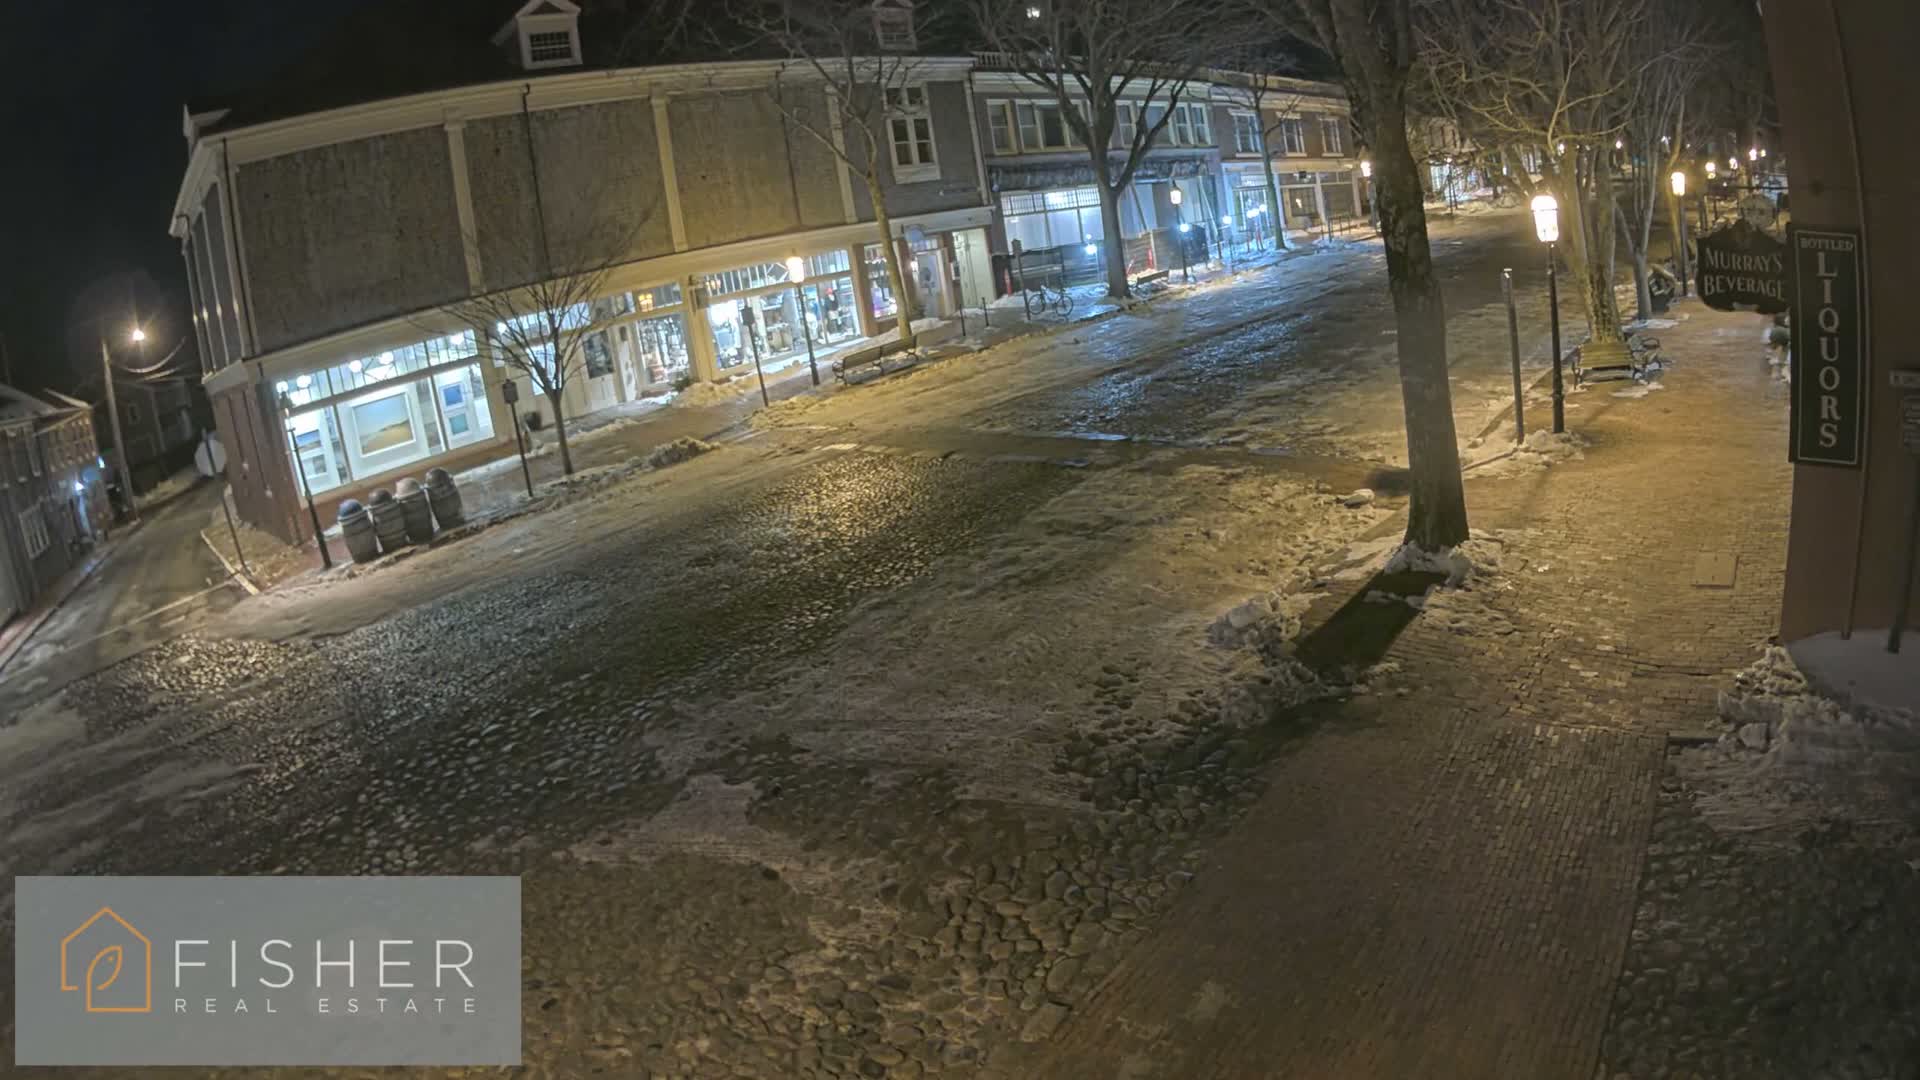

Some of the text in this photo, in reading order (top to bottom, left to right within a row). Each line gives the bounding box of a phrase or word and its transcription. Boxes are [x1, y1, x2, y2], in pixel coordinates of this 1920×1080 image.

[1800, 237, 1854, 251] BOTTLED
[1705, 247, 1783, 273] MURRAY'S
[1703, 274, 1785, 301] BEVERAGE
[1816, 252, 1841, 448] LIQUORS
